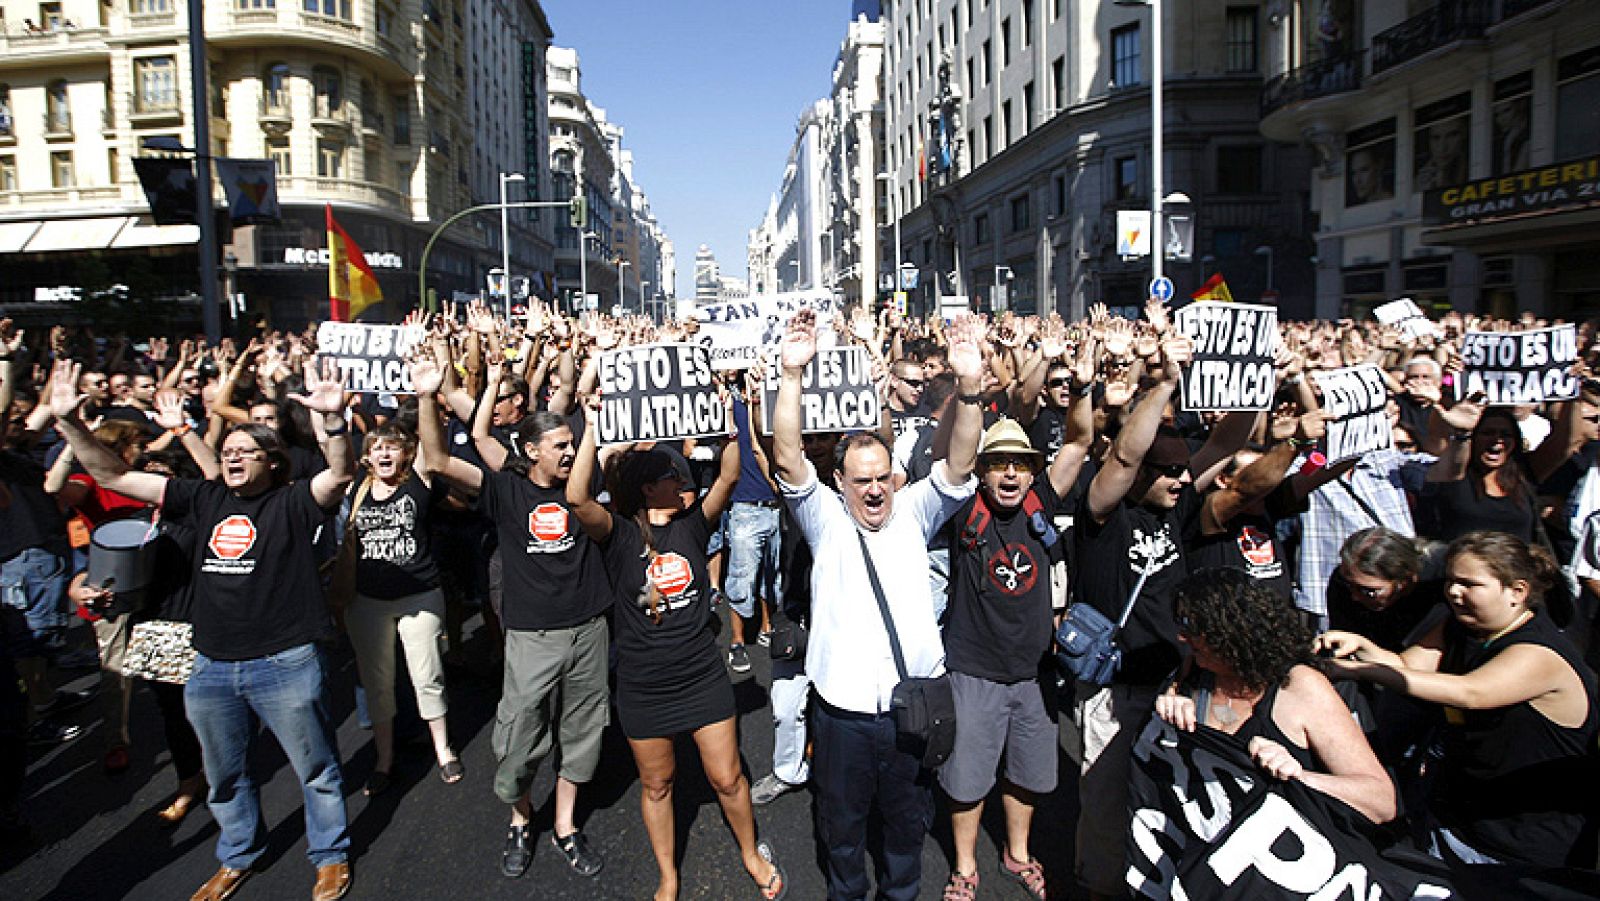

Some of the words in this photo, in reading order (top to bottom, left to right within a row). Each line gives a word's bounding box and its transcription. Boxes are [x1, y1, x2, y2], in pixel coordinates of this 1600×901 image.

[1451, 197, 1516, 218] GRAN
[1523, 187, 1569, 206] VIA
[1577, 181, 1600, 197] 2
[319, 325, 367, 354] ESTO
[367, 327, 394, 355] ES
[1182, 306, 1232, 354] ESTO
[1231, 309, 1256, 356] ES
[1462, 334, 1517, 366] ESTO
[1521, 333, 1549, 366] ES
[324, 358, 413, 391] TRACO
[601, 348, 671, 392] ESTO
[679, 347, 712, 388] ES
[818, 350, 843, 388] ES
[1189, 360, 1272, 408] ATRACO
[1468, 369, 1576, 402] ATRACO
[602, 397, 634, 441] UN
[640, 392, 725, 438] ATRACO
